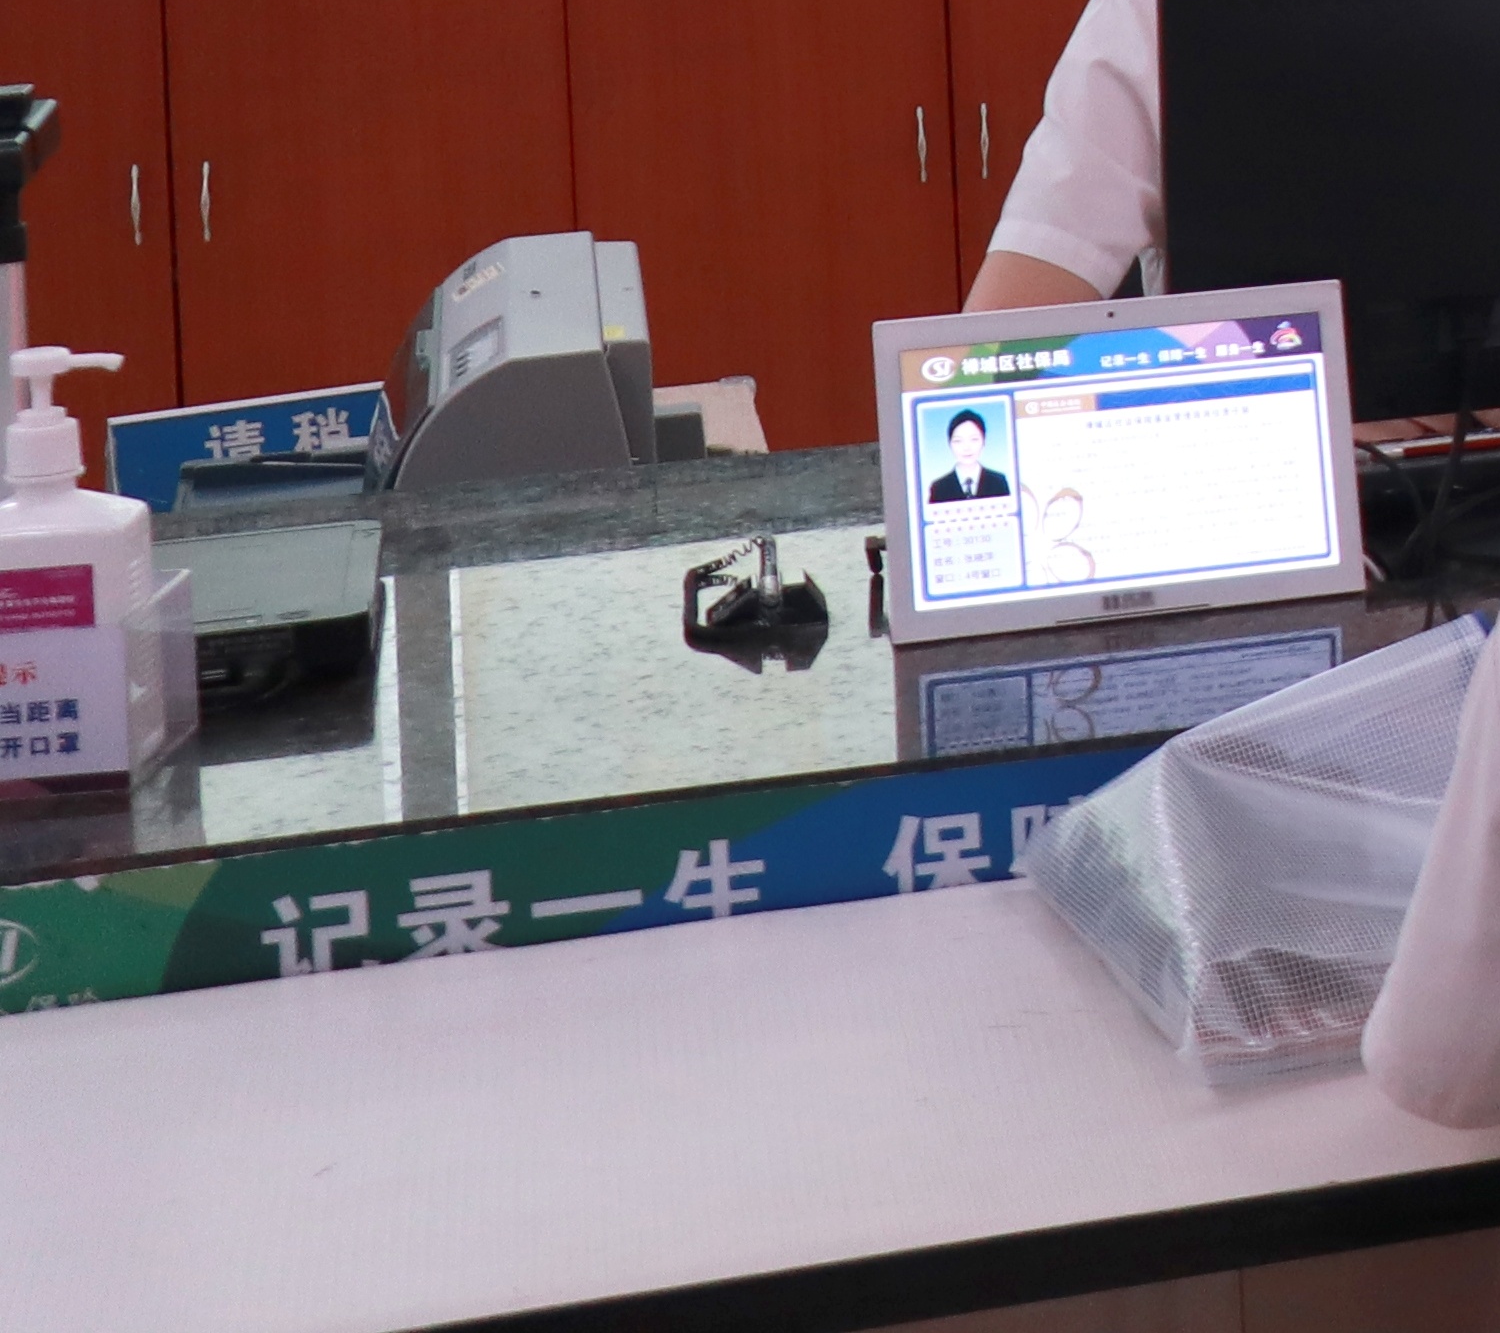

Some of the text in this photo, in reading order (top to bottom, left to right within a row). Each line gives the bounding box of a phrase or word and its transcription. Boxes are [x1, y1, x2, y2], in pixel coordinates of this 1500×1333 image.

[961, 348, 1071, 377] 禅城区社保局
[0, 698, 79, 725] 当距离
[0, 731, 81, 759] 开口罩
[262, 837, 768, 979] 记录一生
